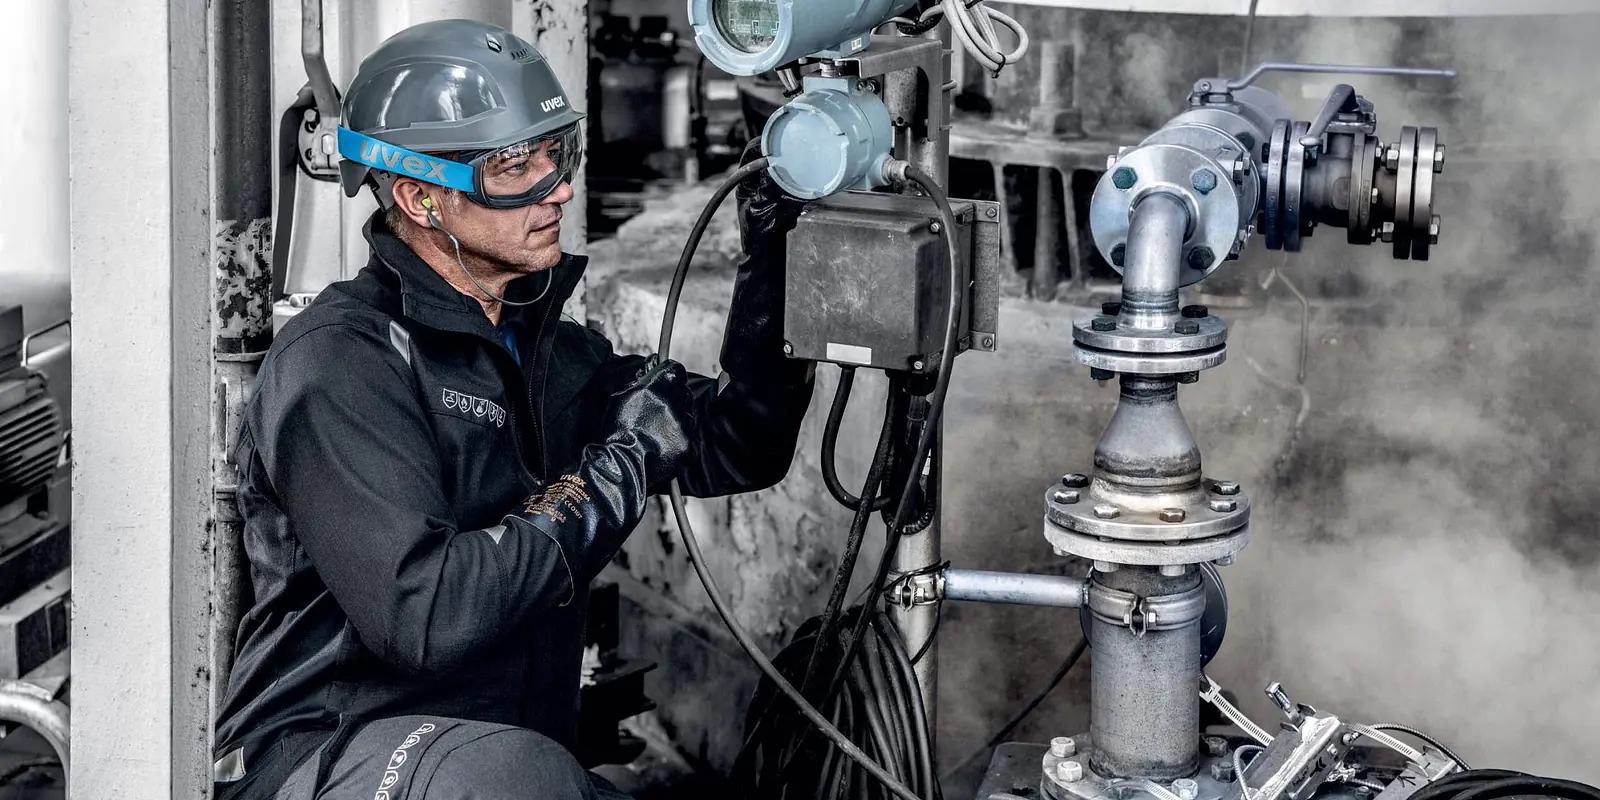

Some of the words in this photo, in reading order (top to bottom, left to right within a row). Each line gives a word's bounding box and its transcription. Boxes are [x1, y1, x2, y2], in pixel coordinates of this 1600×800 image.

[540, 95, 566, 113] uvex
[360, 141, 449, 182] uvex
[560, 474, 587, 488] uvex
